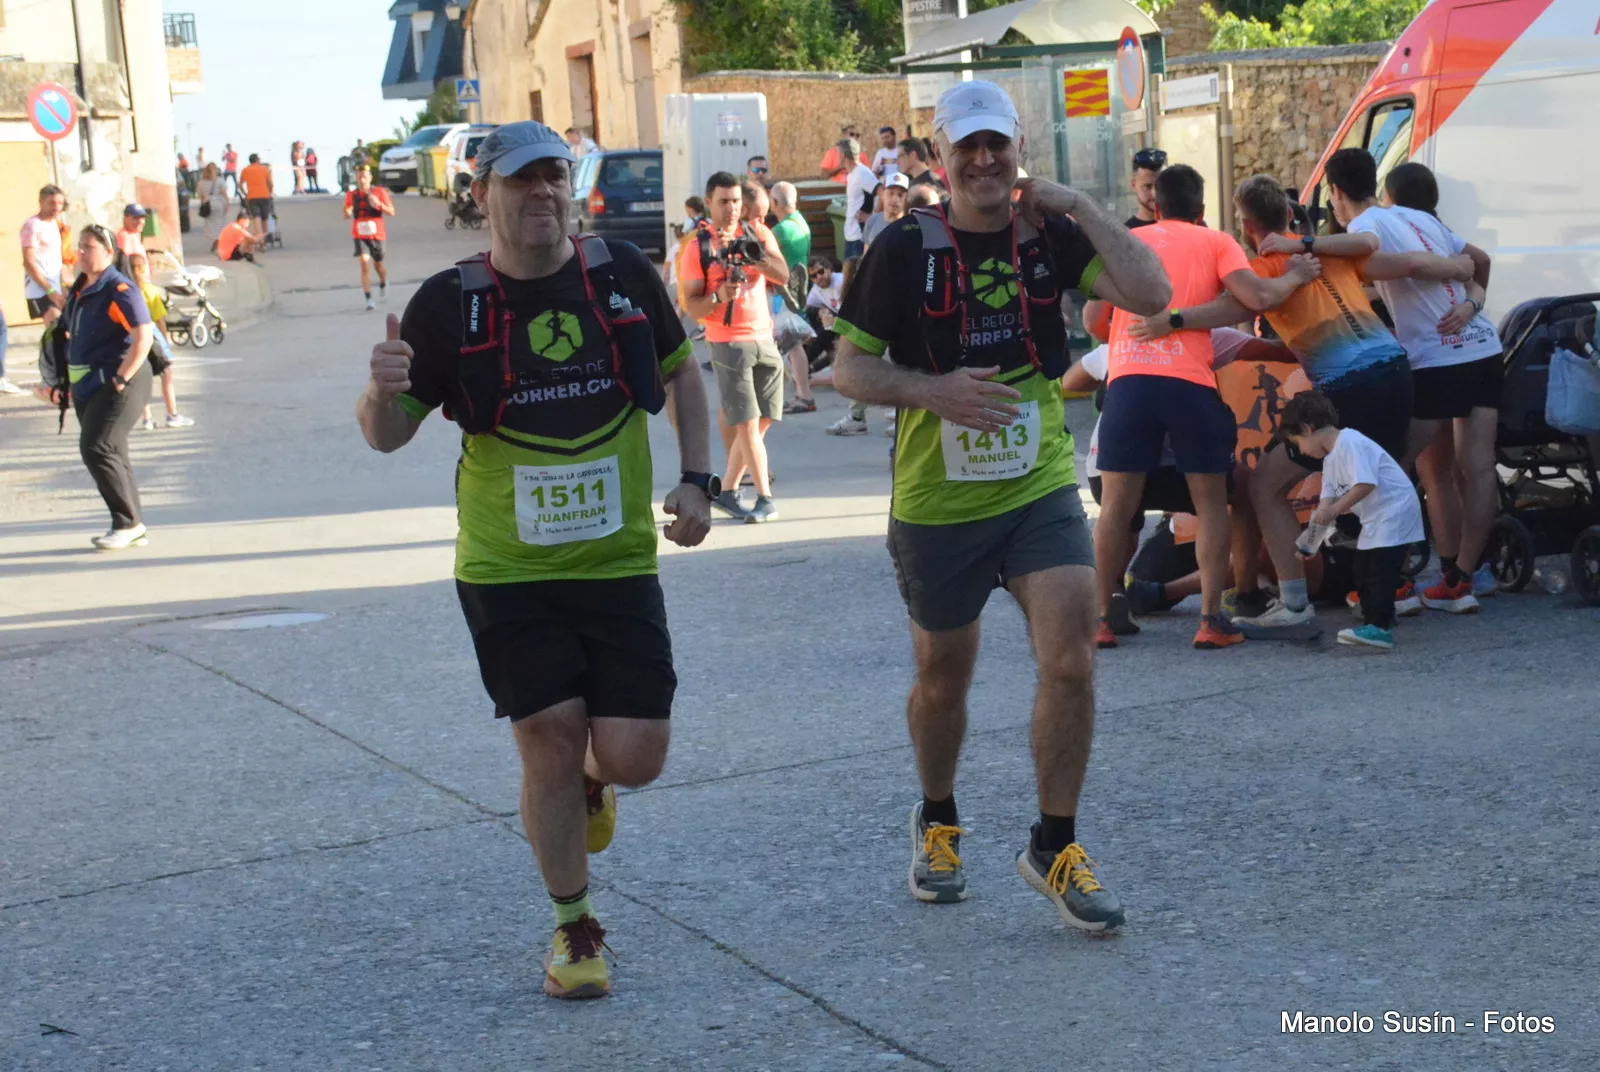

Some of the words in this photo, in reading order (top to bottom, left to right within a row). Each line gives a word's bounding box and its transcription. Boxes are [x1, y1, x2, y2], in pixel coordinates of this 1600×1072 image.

[926, 254, 935, 292] AONIJIE
[470, 294, 479, 332] AONIJIE
[982, 313, 1015, 328] RETO
[956, 424, 1029, 452] 1413
[968, 450, 1021, 464] MANUEL
[530, 478, 605, 508] 1511
[533, 505, 606, 524] JUANFRAN
